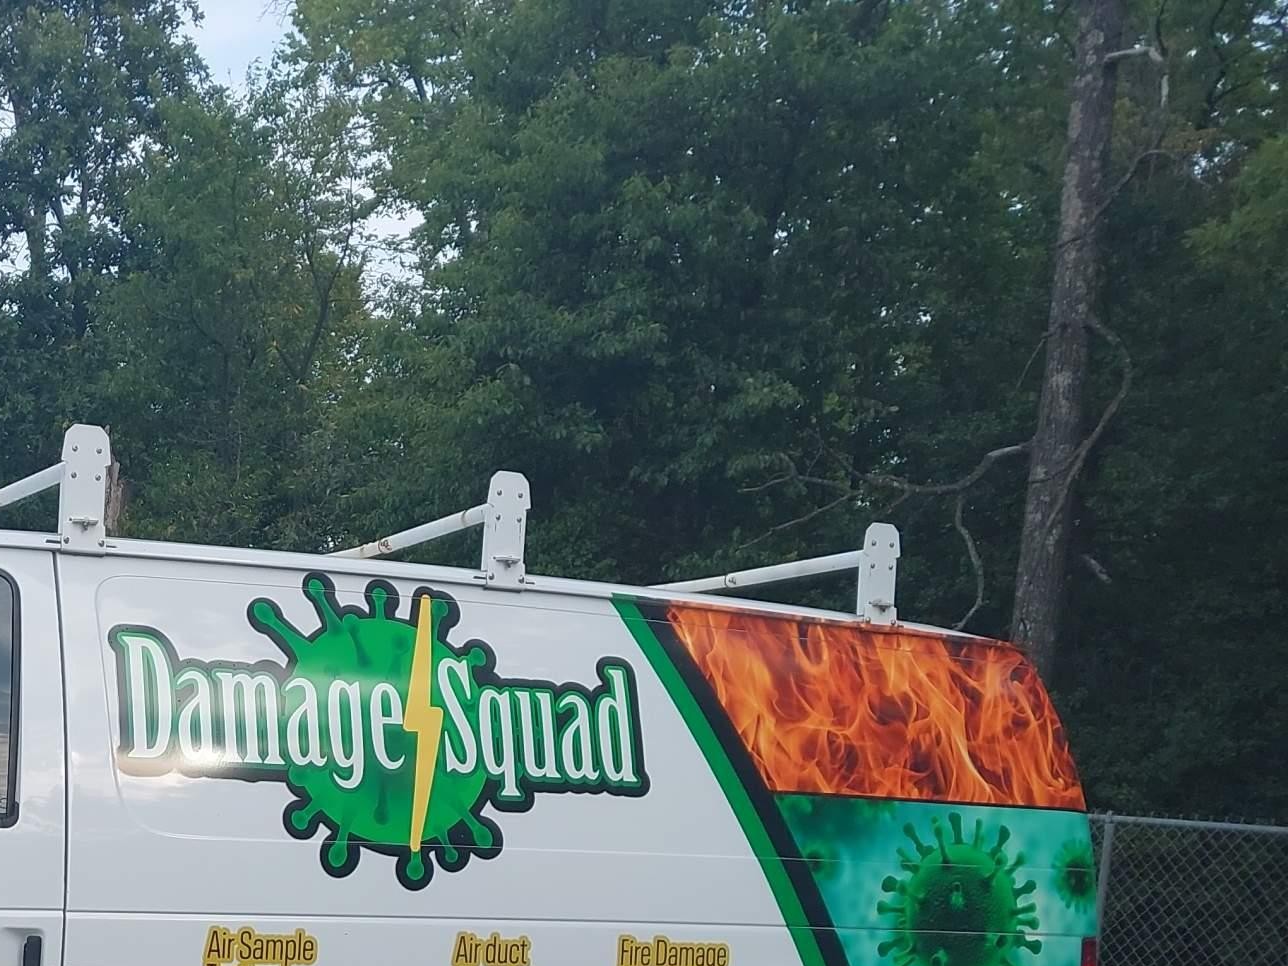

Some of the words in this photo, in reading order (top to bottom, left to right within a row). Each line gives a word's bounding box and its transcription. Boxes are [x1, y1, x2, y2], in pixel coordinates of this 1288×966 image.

[120, 636, 406, 790] Damage
[438, 657, 638, 797] Squad
[207, 930, 235, 960] Air
[240, 932, 314, 966] Sample
[455, 935, 480, 964] Air
[486, 936, 527, 965] duct
[620, 938, 651, 966] Fire
